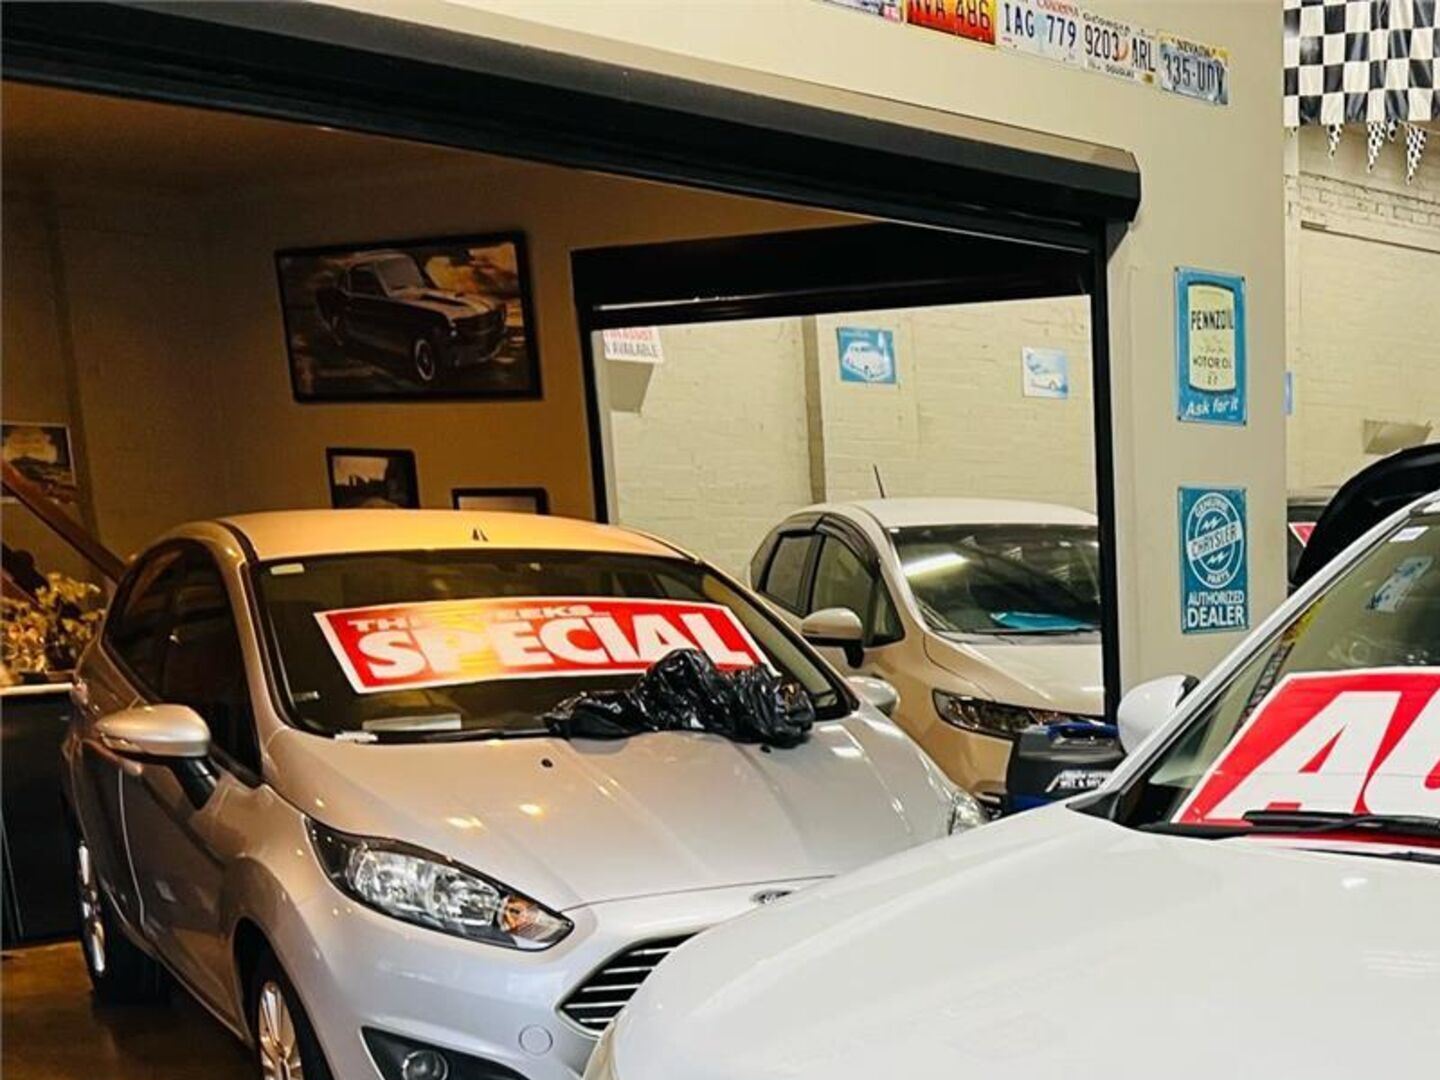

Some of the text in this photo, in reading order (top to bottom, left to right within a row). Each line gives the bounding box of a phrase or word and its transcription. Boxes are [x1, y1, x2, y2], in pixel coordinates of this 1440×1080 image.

[956, 0, 990, 30] 486
[1004, 3, 1076, 48] IAG 779
[1085, 24, 1156, 73] 9203 ARL
[1191, 311, 1234, 330] PENNZOIL
[1186, 397, 1240, 416] Ask for it
[1192, 524, 1238, 557] CHRYSLER
[1188, 590, 1245, 606] AUTHORIZED
[1187, 606, 1245, 628] DEALER
[357, 612, 755, 679] SPECIAL
